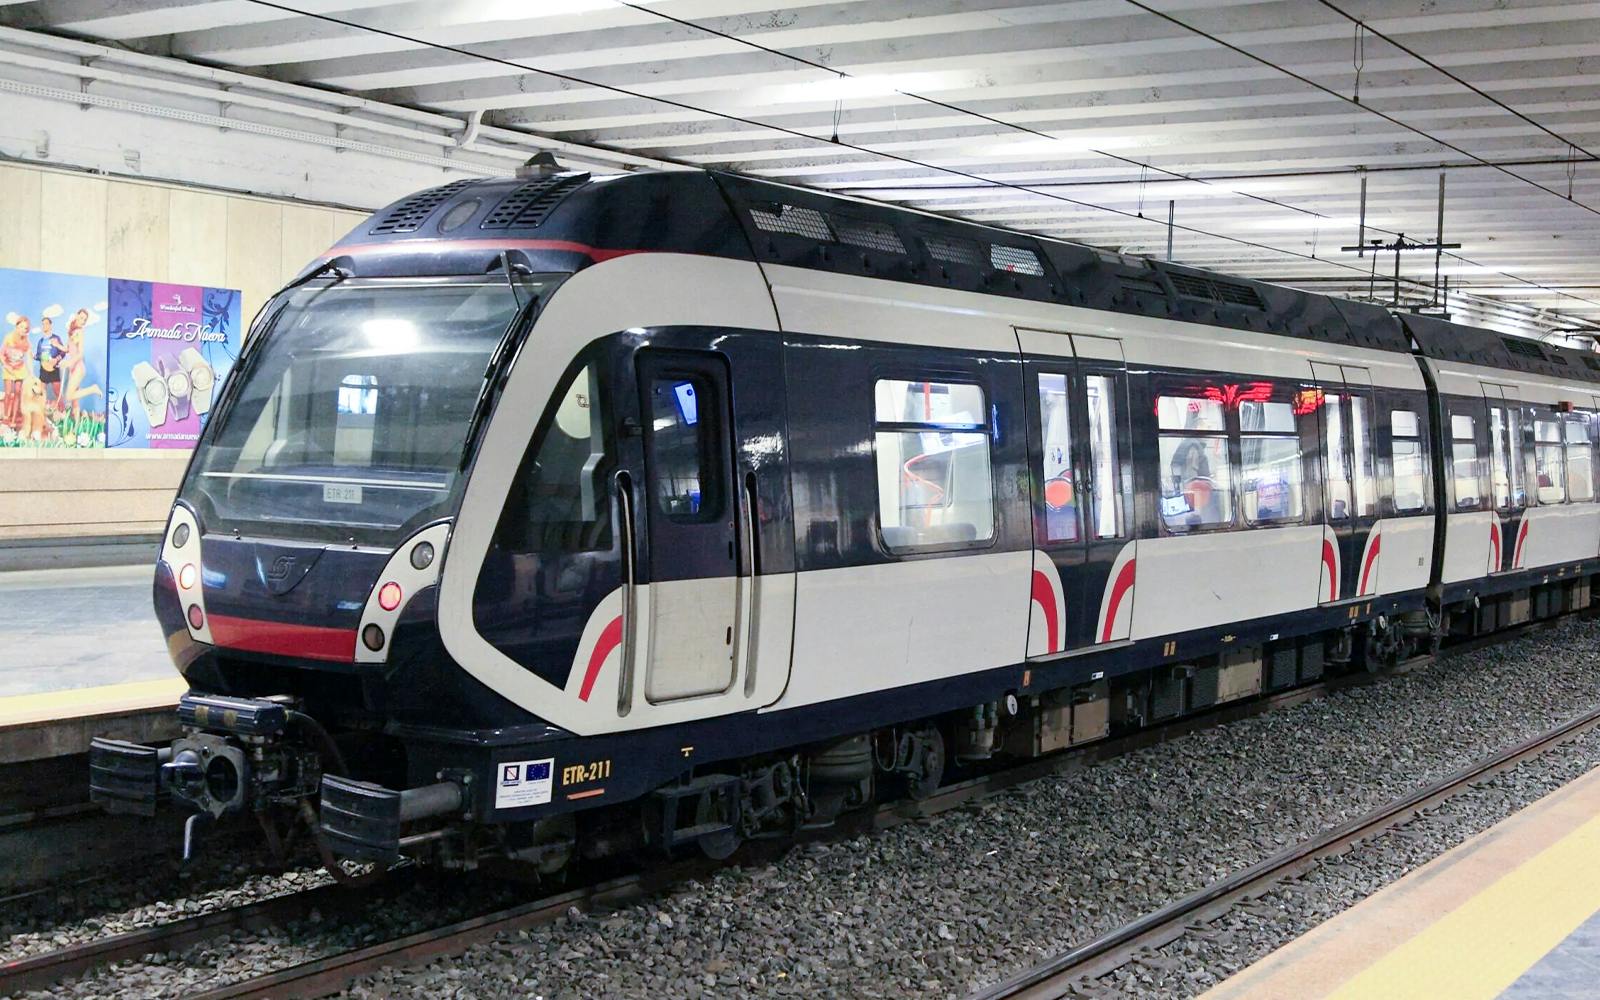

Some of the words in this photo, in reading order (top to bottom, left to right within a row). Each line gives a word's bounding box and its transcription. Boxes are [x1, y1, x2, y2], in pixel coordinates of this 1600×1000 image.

[127, 318, 181, 339] Armada
[184, 323, 226, 342] Nueva
[562, 760, 611, 786] ETR-211
